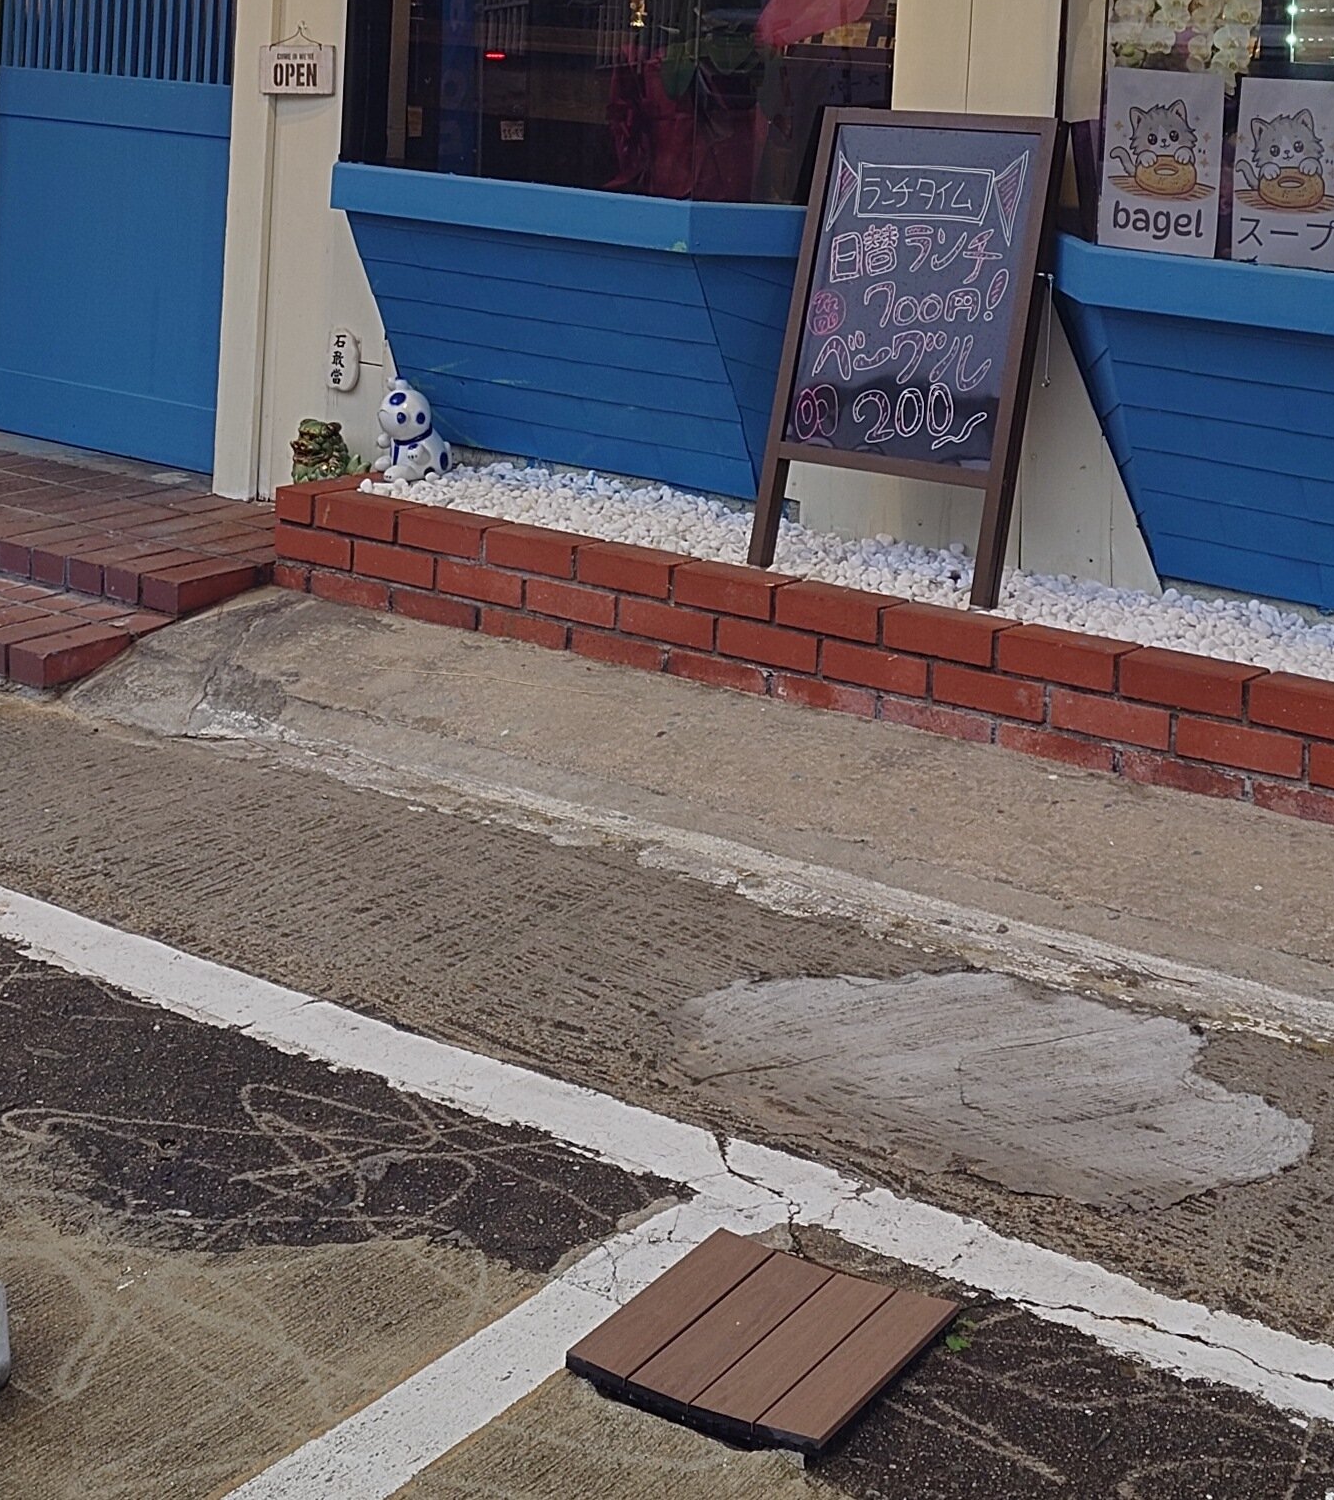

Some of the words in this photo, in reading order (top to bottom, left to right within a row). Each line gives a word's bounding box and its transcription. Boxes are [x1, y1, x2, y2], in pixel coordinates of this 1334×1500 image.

[273, 63, 318, 88] OPEN
[862, 176, 973, 211] ランチタイム
[1112, 200, 1204, 241] bagel
[829, 223, 1004, 284] 日替ランチ
[811, 329, 993, 392] ベーグル
